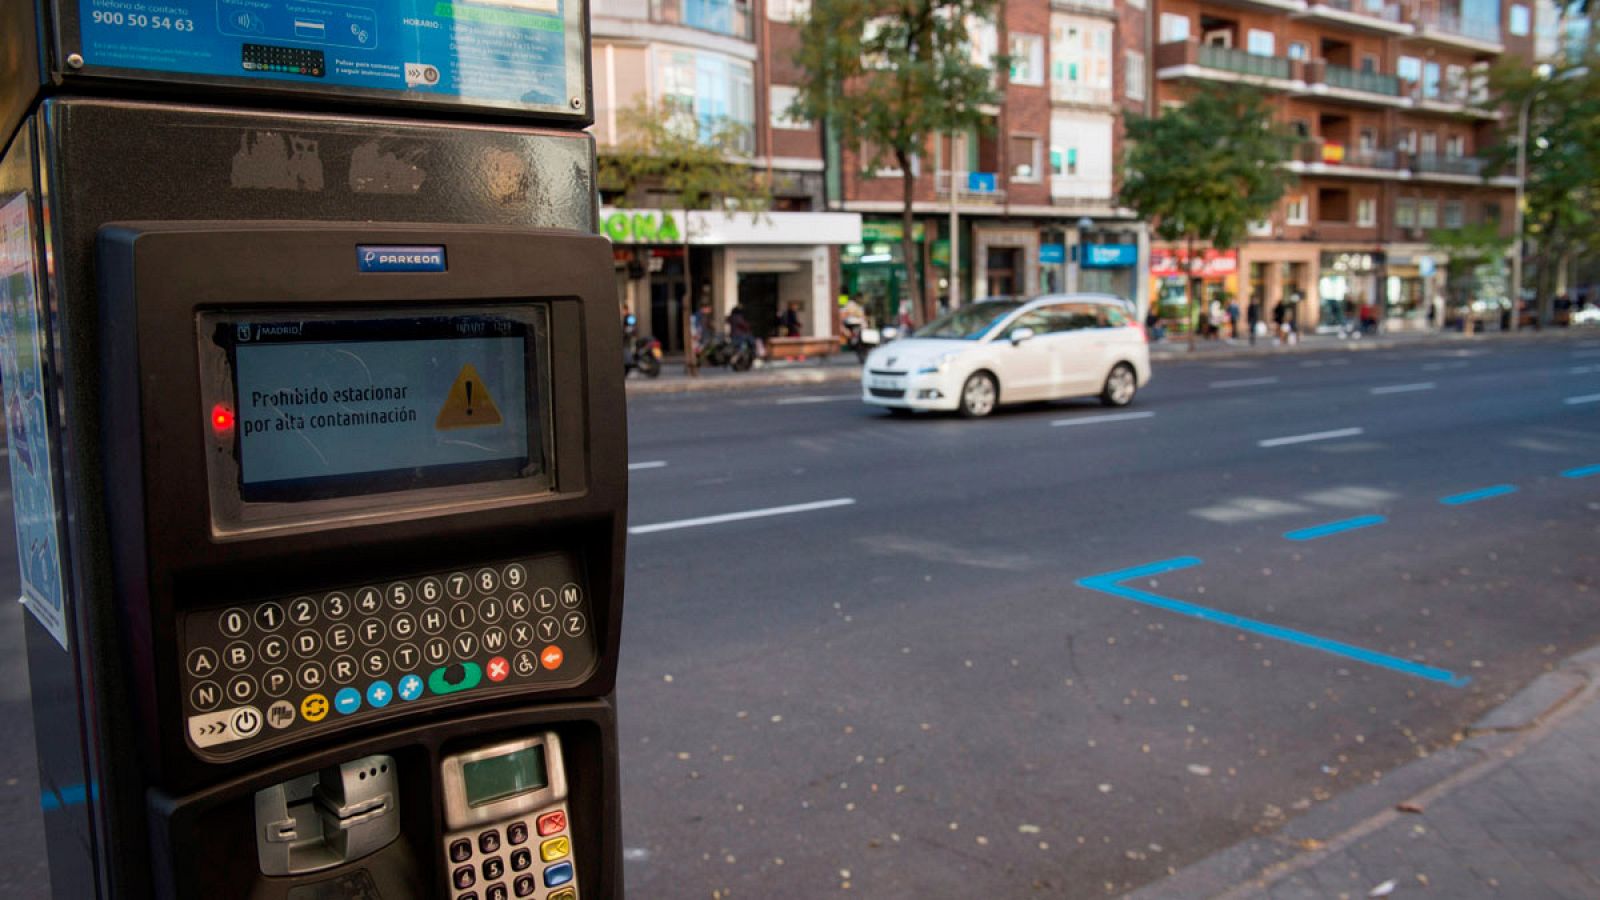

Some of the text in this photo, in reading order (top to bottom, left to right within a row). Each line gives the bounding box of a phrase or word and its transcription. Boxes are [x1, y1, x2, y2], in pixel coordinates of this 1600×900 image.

[92, 10, 194, 32] 900 50 54 63
[147, 6, 189, 16] contacto
[379, 255, 440, 265] PARKEON
[251, 384, 408, 407] Prohibido estacionar
[244, 406, 417, 436] por alta contaminación
[264, 608, 274, 626] 1
[297, 602, 310, 621] 2
[331, 597, 343, 615] 3
[362, 592, 375, 609] 4
[395, 587, 405, 604] 5
[424, 582, 436, 599] 6
[452, 577, 463, 594] 7
[482, 573, 492, 589] 8
[509, 568, 520, 585] 9
[196, 655, 212, 671] A
[232, 648, 246, 664] B
[267, 642, 280, 657] C
[300, 636, 314, 651] D
[334, 630, 347, 645] E
[367, 624, 376, 640] F
[397, 619, 410, 634] G
[427, 613, 440, 628] H
[487, 603, 495, 618] J
[512, 598, 524, 613] K
[540, 594, 551, 608] L
[564, 588, 577, 603] M
[200, 688, 213, 704] N
[272, 674, 284, 690] P
[304, 668, 320, 684] Q
[337, 662, 351, 677] R
[370, 656, 382, 670] S
[400, 649, 412, 664] T
[431, 644, 443, 658] U
[460, 638, 471, 652] V
[486, 632, 502, 648] W
[516, 627, 528, 642] X
[543, 622, 553, 636] Y
[570, 617, 580, 631] Z
[489, 864, 498, 875] 5
